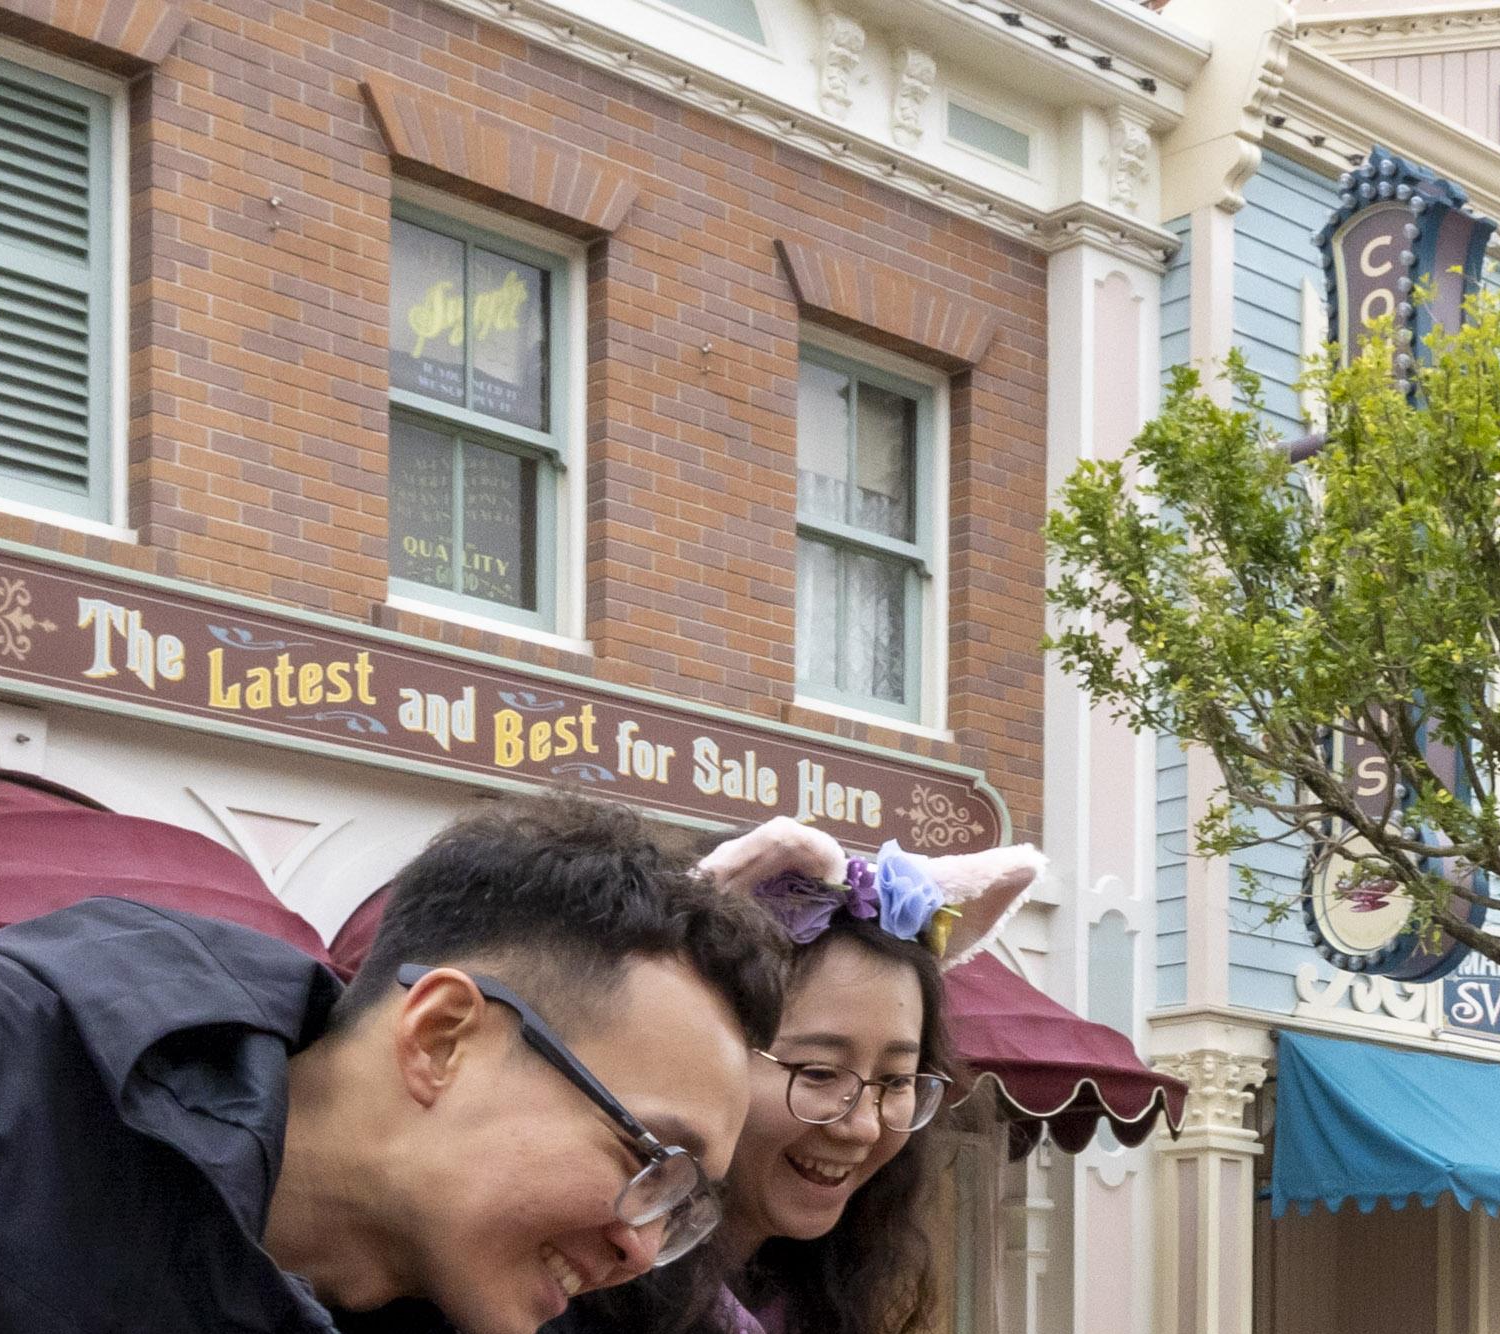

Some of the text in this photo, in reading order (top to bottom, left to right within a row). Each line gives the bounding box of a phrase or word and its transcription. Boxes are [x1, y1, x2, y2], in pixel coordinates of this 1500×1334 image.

[77, 597, 882, 828] The Latest and Best for Sale Here
